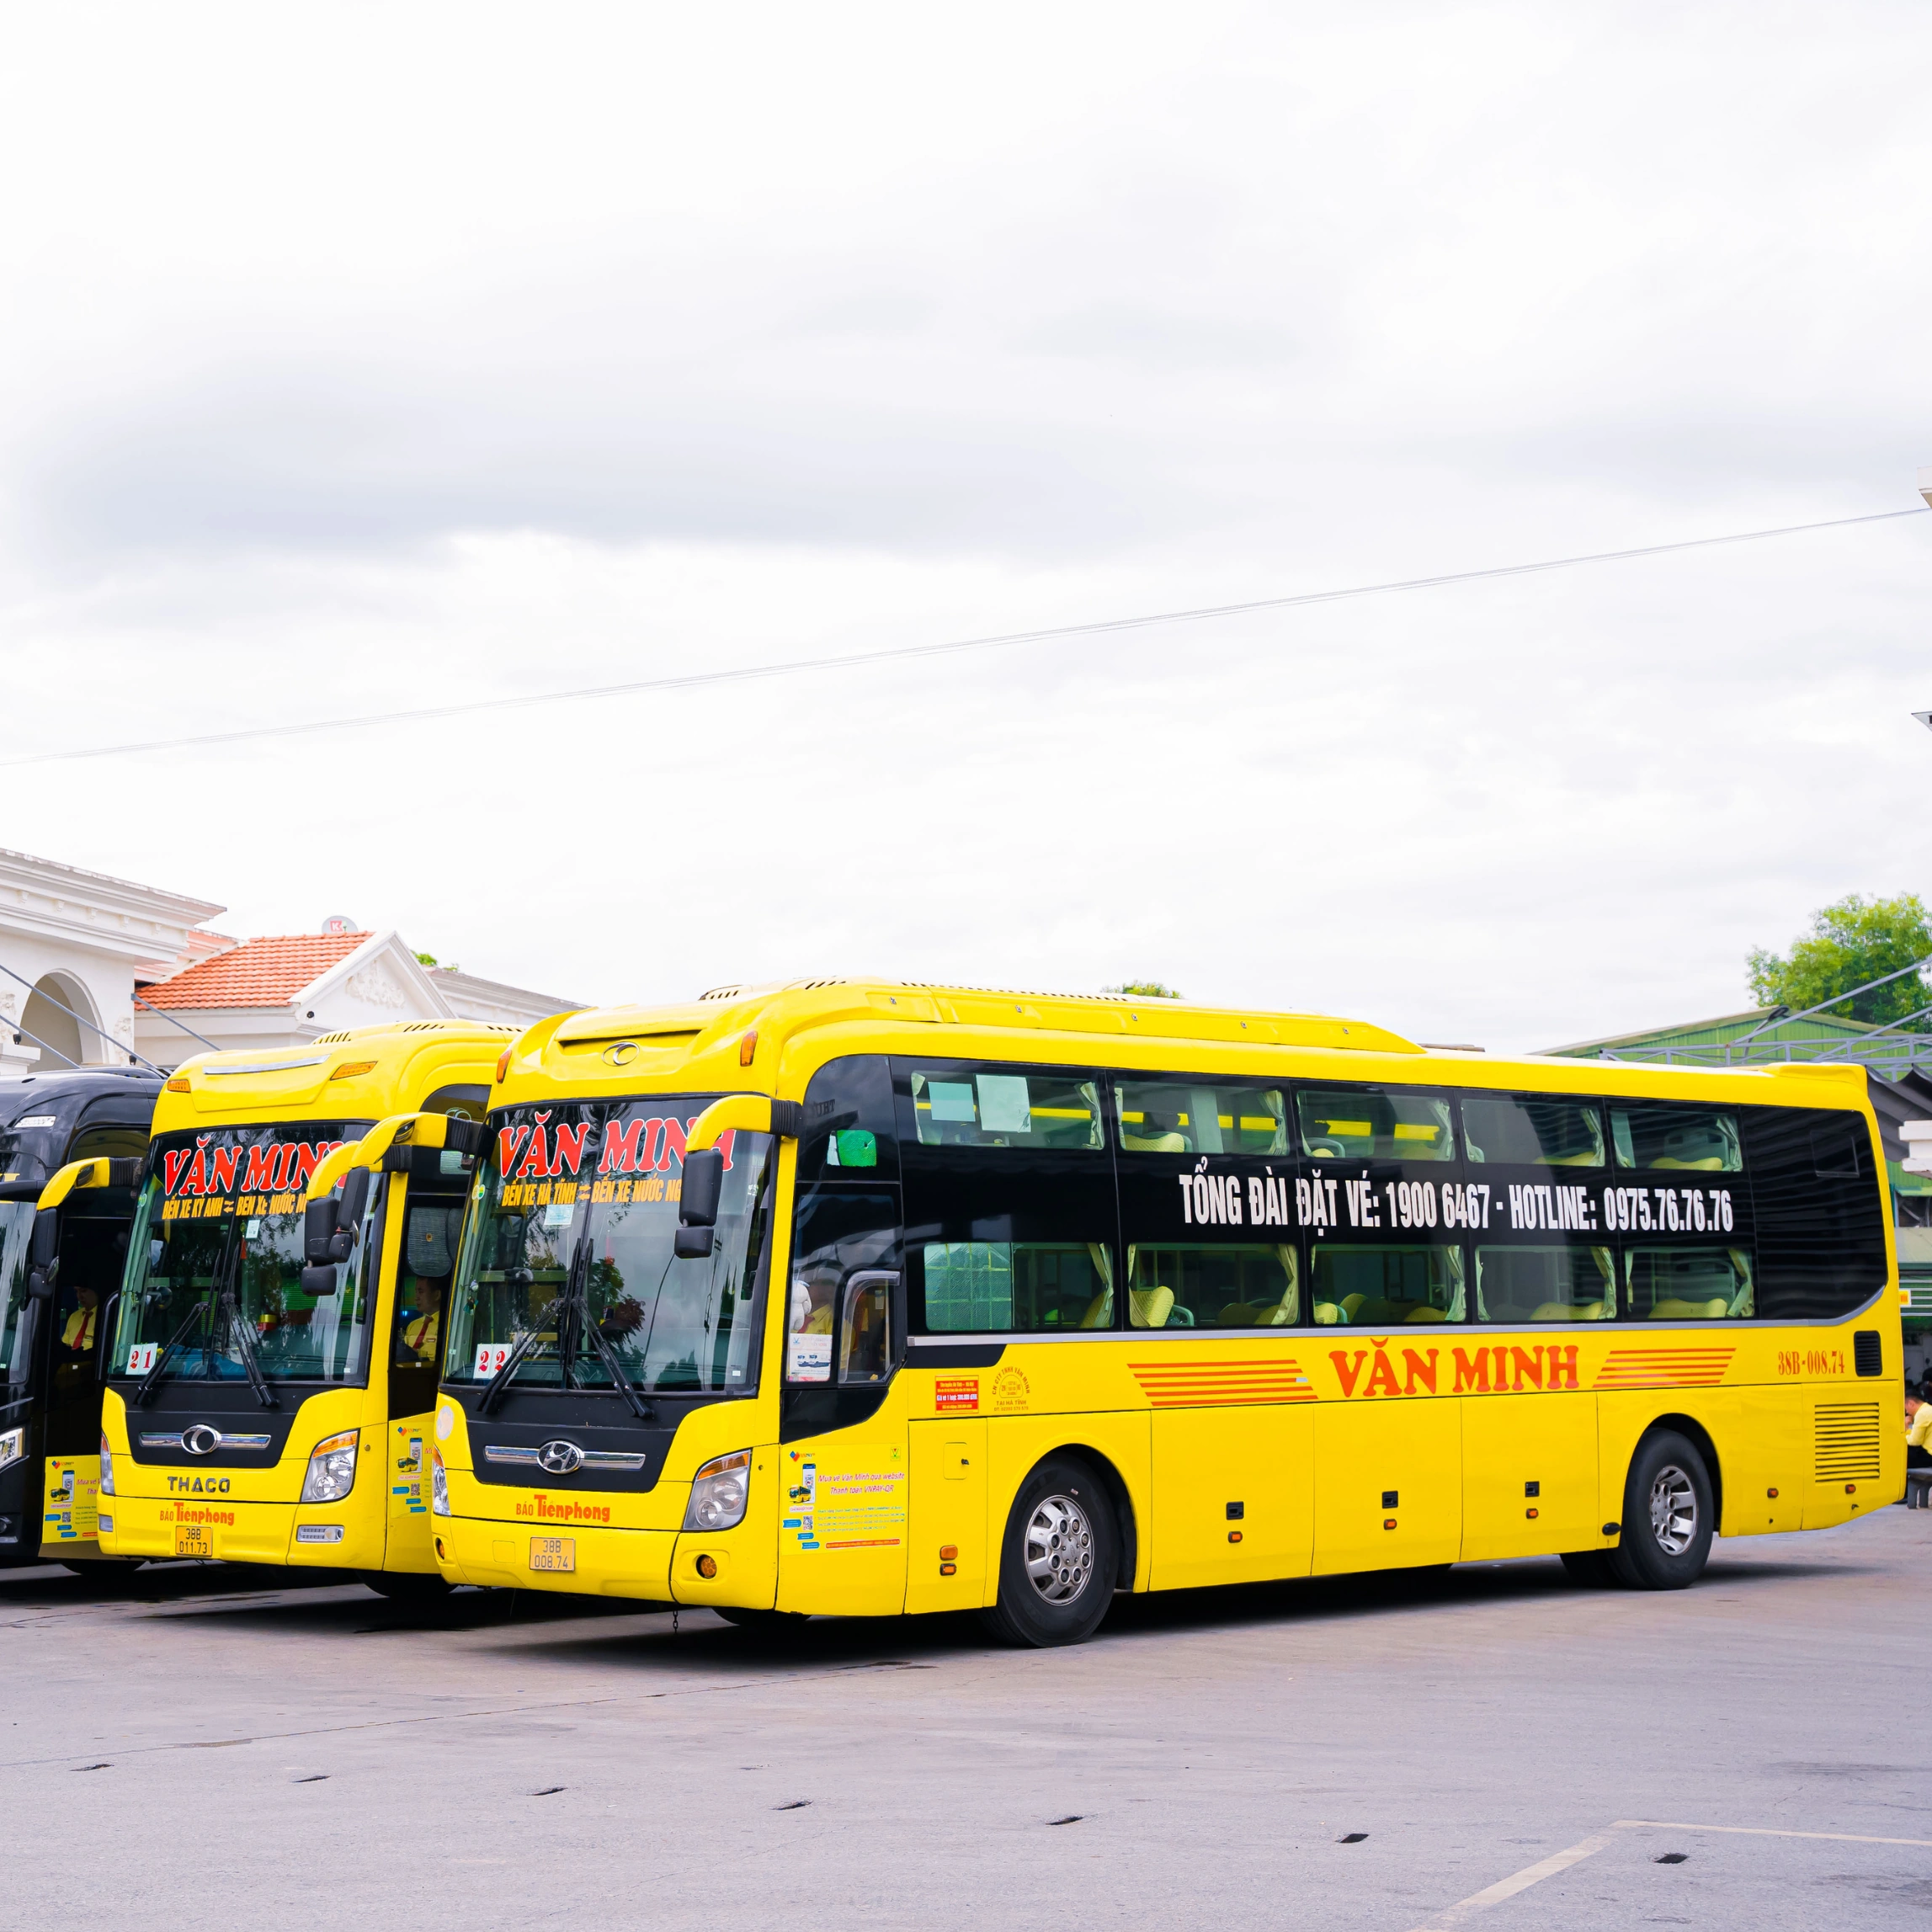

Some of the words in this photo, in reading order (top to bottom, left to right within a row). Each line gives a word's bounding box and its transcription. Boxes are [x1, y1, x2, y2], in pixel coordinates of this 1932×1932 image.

[498, 1110, 590, 1178] VĂN
[164, 1136, 242, 1195] VĂN
[241, 1140, 360, 1191] MIN
[522, 1184, 537, 1206] XE
[536, 1178, 552, 1206] HÀ
[615, 1179, 631, 1203] XE
[665, 1179, 682, 1202] NG
[1179, 1156, 1243, 1225] TỔNG
[1248, 1166, 1289, 1225] ĐÀI
[1296, 1168, 1338, 1237] ĐẶT
[1345, 1170, 1381, 1227] VÉ:
[1386, 1181, 1437, 1228] 1900
[1441, 1183, 1490, 1229] 6467
[1509, 1184, 1597, 1230] HOTLINE:
[1604, 1187, 1733, 1232] 0975.76.76.76
[179, 1199, 191, 1218] XE
[203, 1197, 224, 1217] ANH
[1328, 1337, 1440, 1397] VĂN
[1451, 1344, 1580, 1393] MINH
[1778, 1350, 1845, 1376] 38B-008.74
[167, 1477, 231, 1493] THACO
[882, 1472, 905, 1480] website
[185, 1528, 201, 1540] 38B
[179, 1541, 208, 1554] 011.73
[543, 1540, 562, 1553] 38B
[535, 1555, 568, 1569] 008.74
